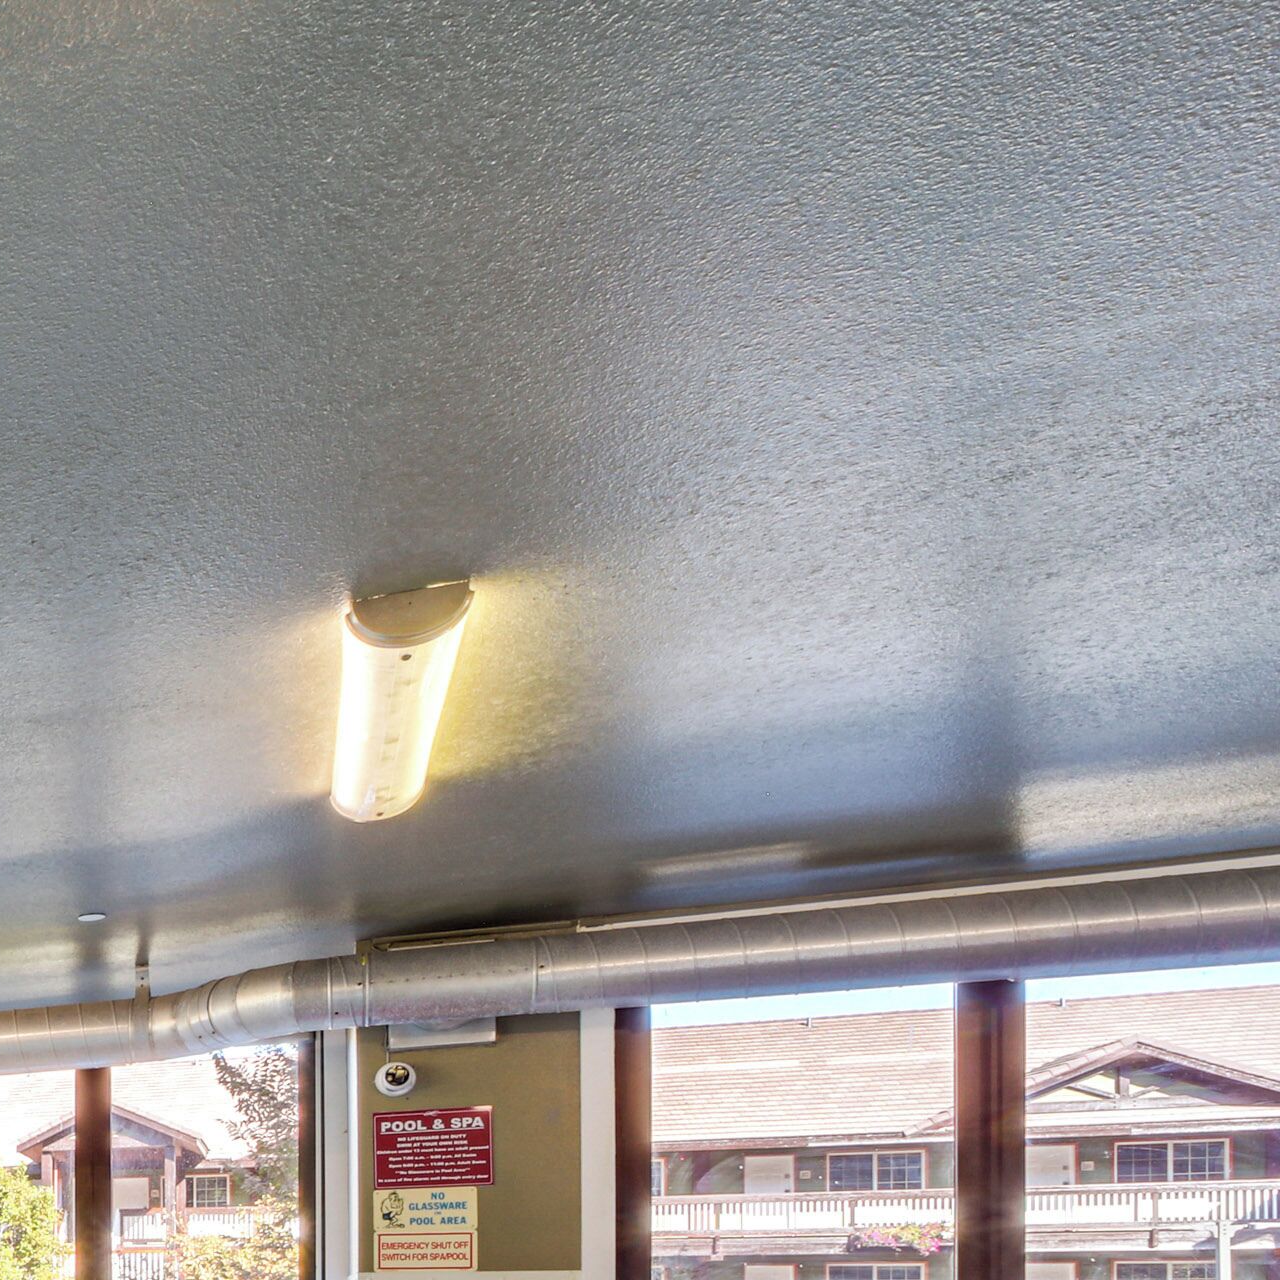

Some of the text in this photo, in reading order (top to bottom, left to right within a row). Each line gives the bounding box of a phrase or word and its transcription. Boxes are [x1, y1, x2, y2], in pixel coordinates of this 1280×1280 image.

[381, 1117, 484, 1132] POOL & SPA
[431, 1192, 445, 1200] NO
[409, 1202, 467, 1210] GLASSWARE
[410, 1217, 435, 1225] POOL
[382, 1242, 430, 1250] EMERGENCY
[431, 1241, 451, 1249] SHUT
[412, 1253, 428, 1261] FOR
